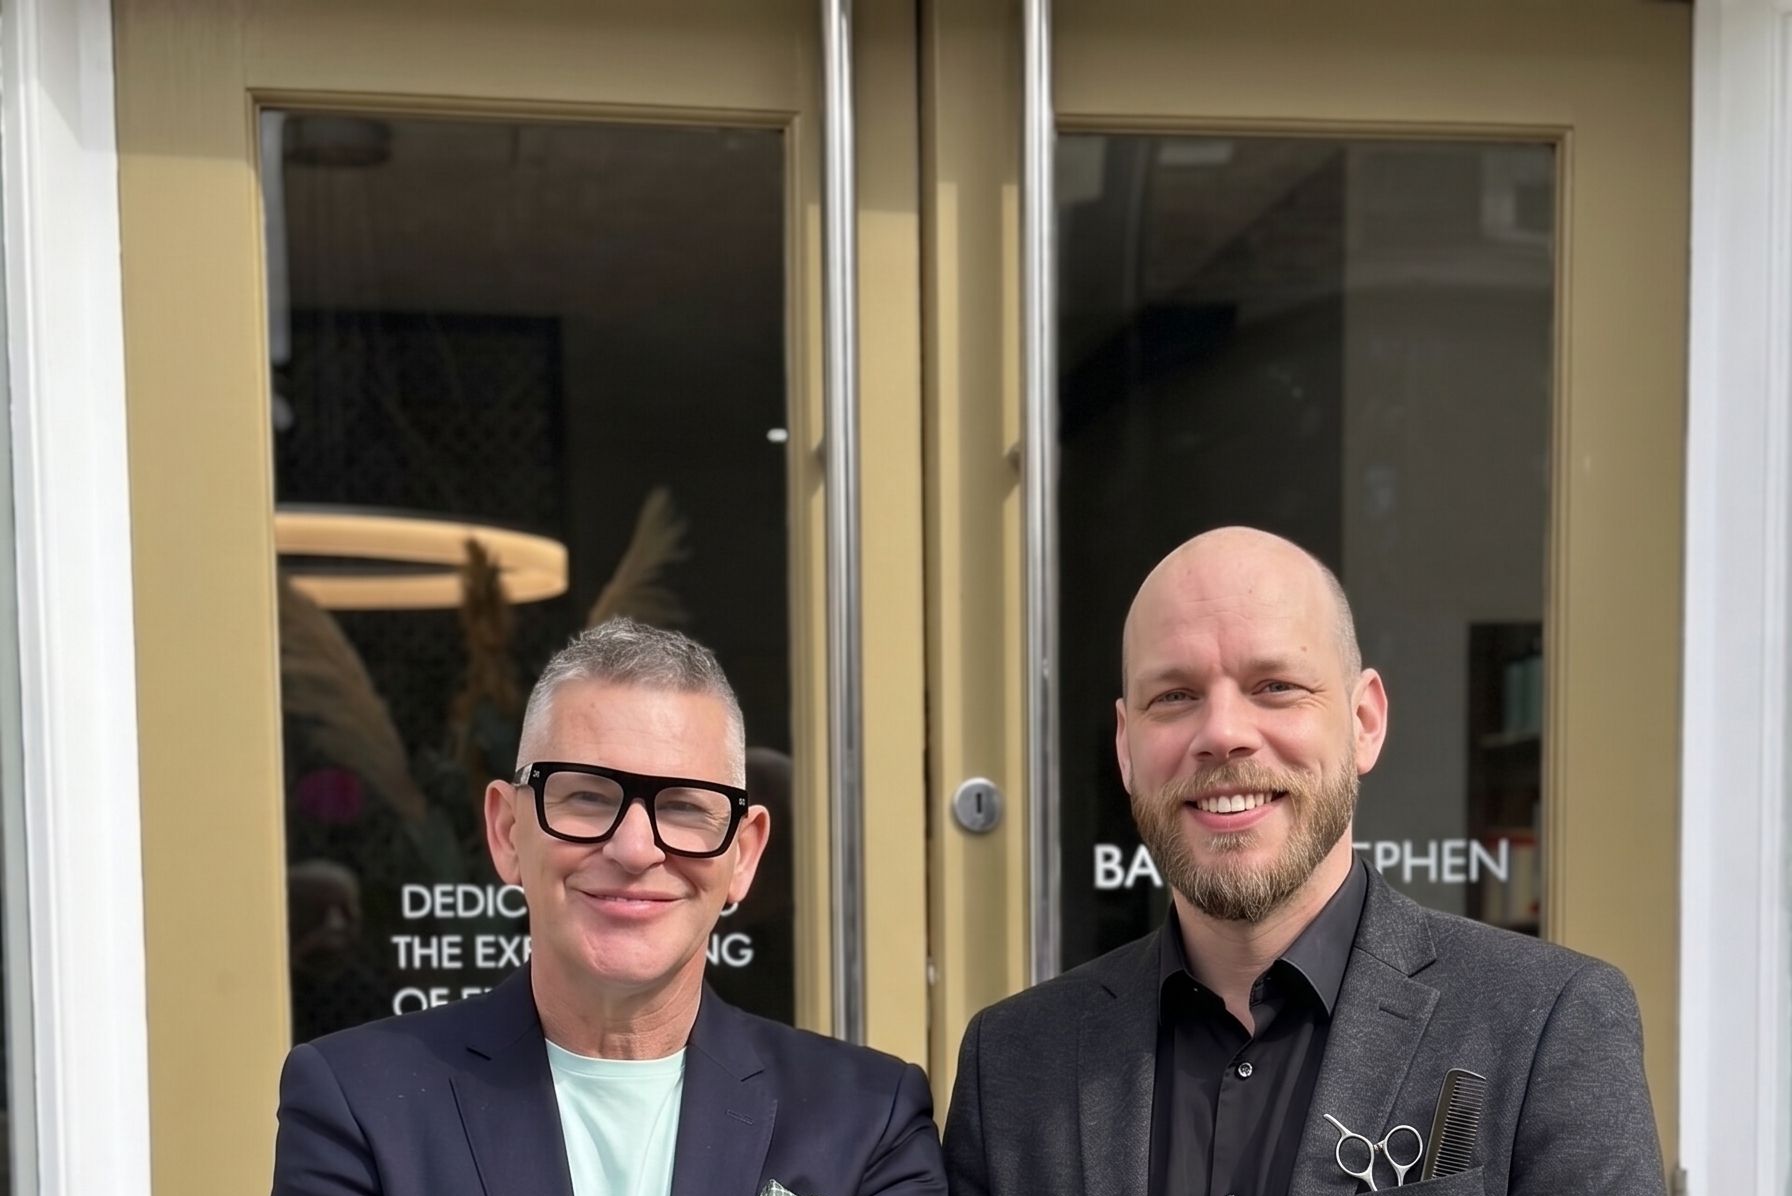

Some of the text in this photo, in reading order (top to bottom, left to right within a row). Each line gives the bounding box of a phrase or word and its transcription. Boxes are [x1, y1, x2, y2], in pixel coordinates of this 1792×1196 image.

[1352, 839, 1508, 884] PHEN
[402, 884, 528, 919] DEDIC
[391, 935, 463, 969] THE
